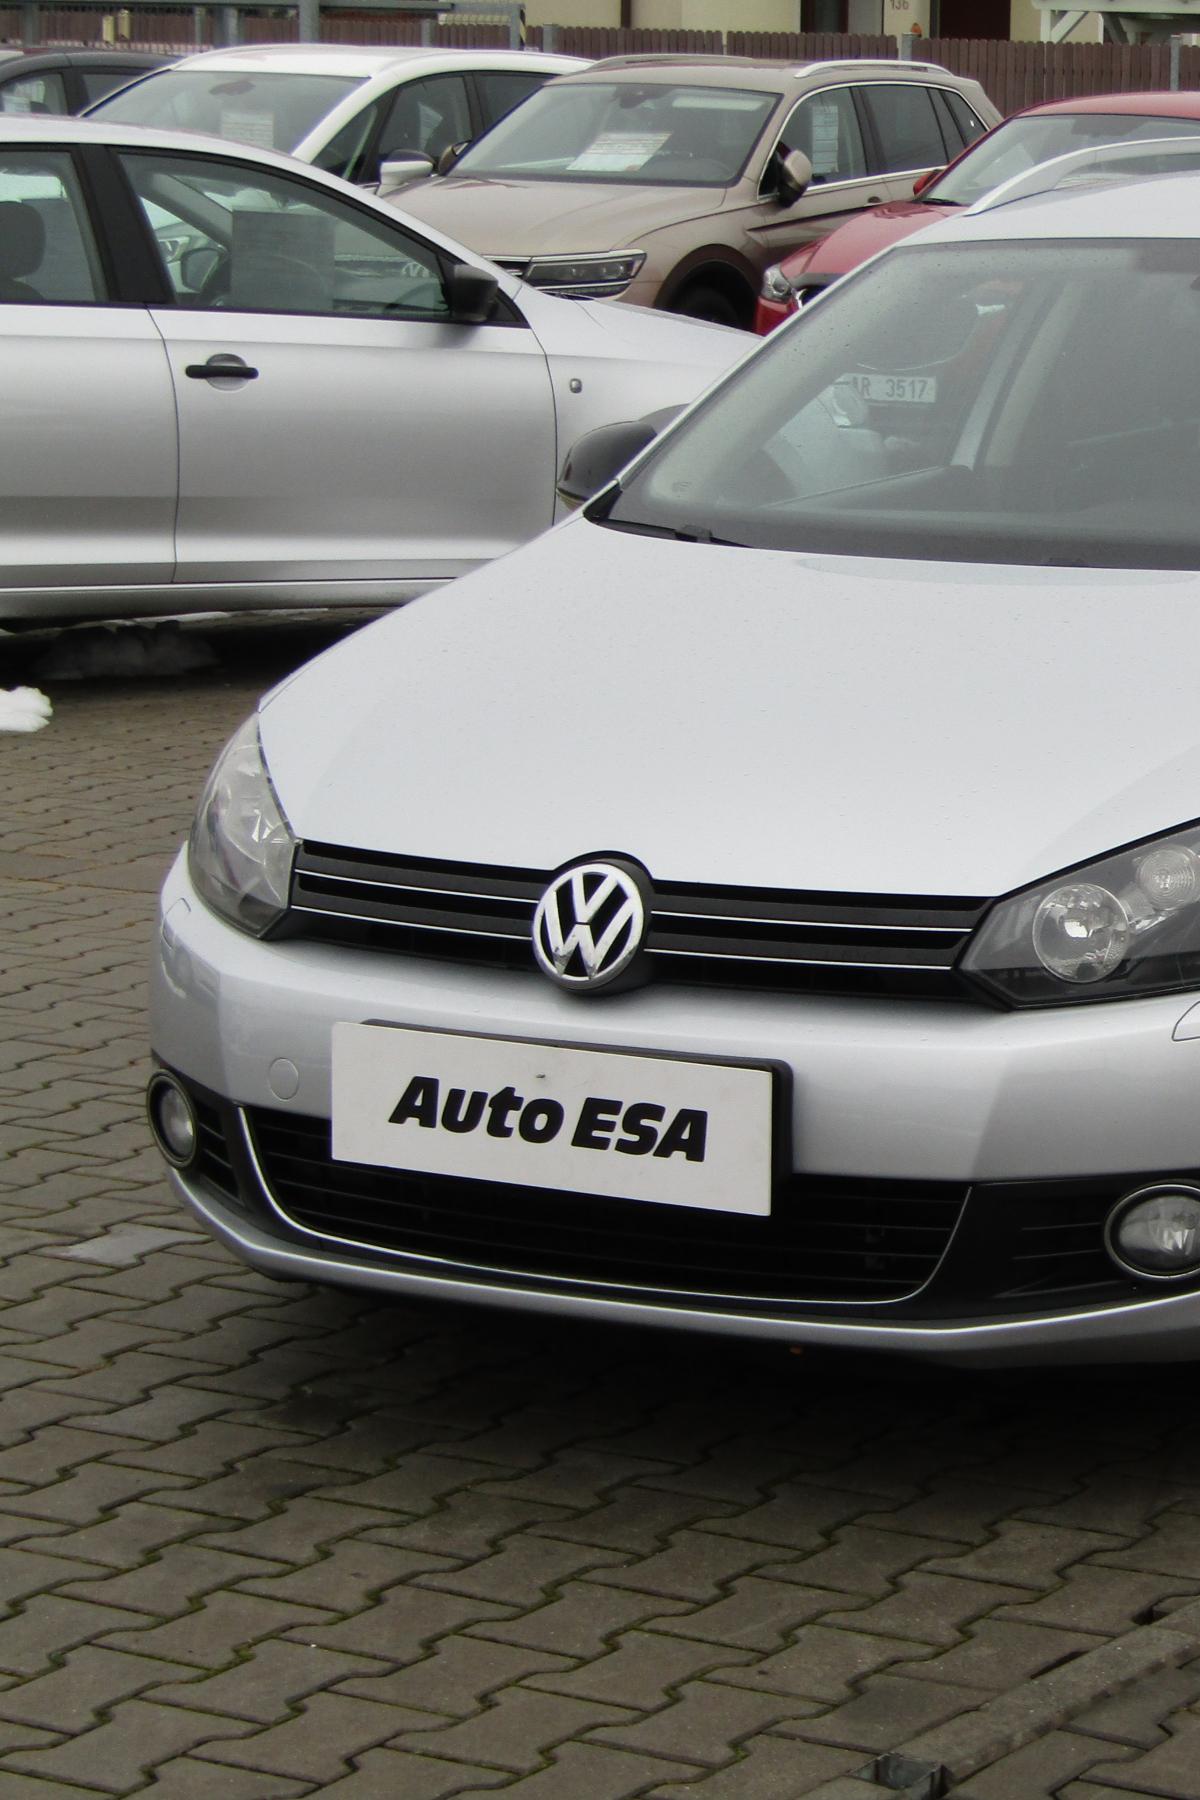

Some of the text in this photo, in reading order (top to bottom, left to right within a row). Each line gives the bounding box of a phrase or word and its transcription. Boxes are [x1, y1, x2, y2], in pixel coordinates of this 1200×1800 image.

[885, 378, 928, 399] 3517
[388, 1075, 708, 1163] Auto ESA
